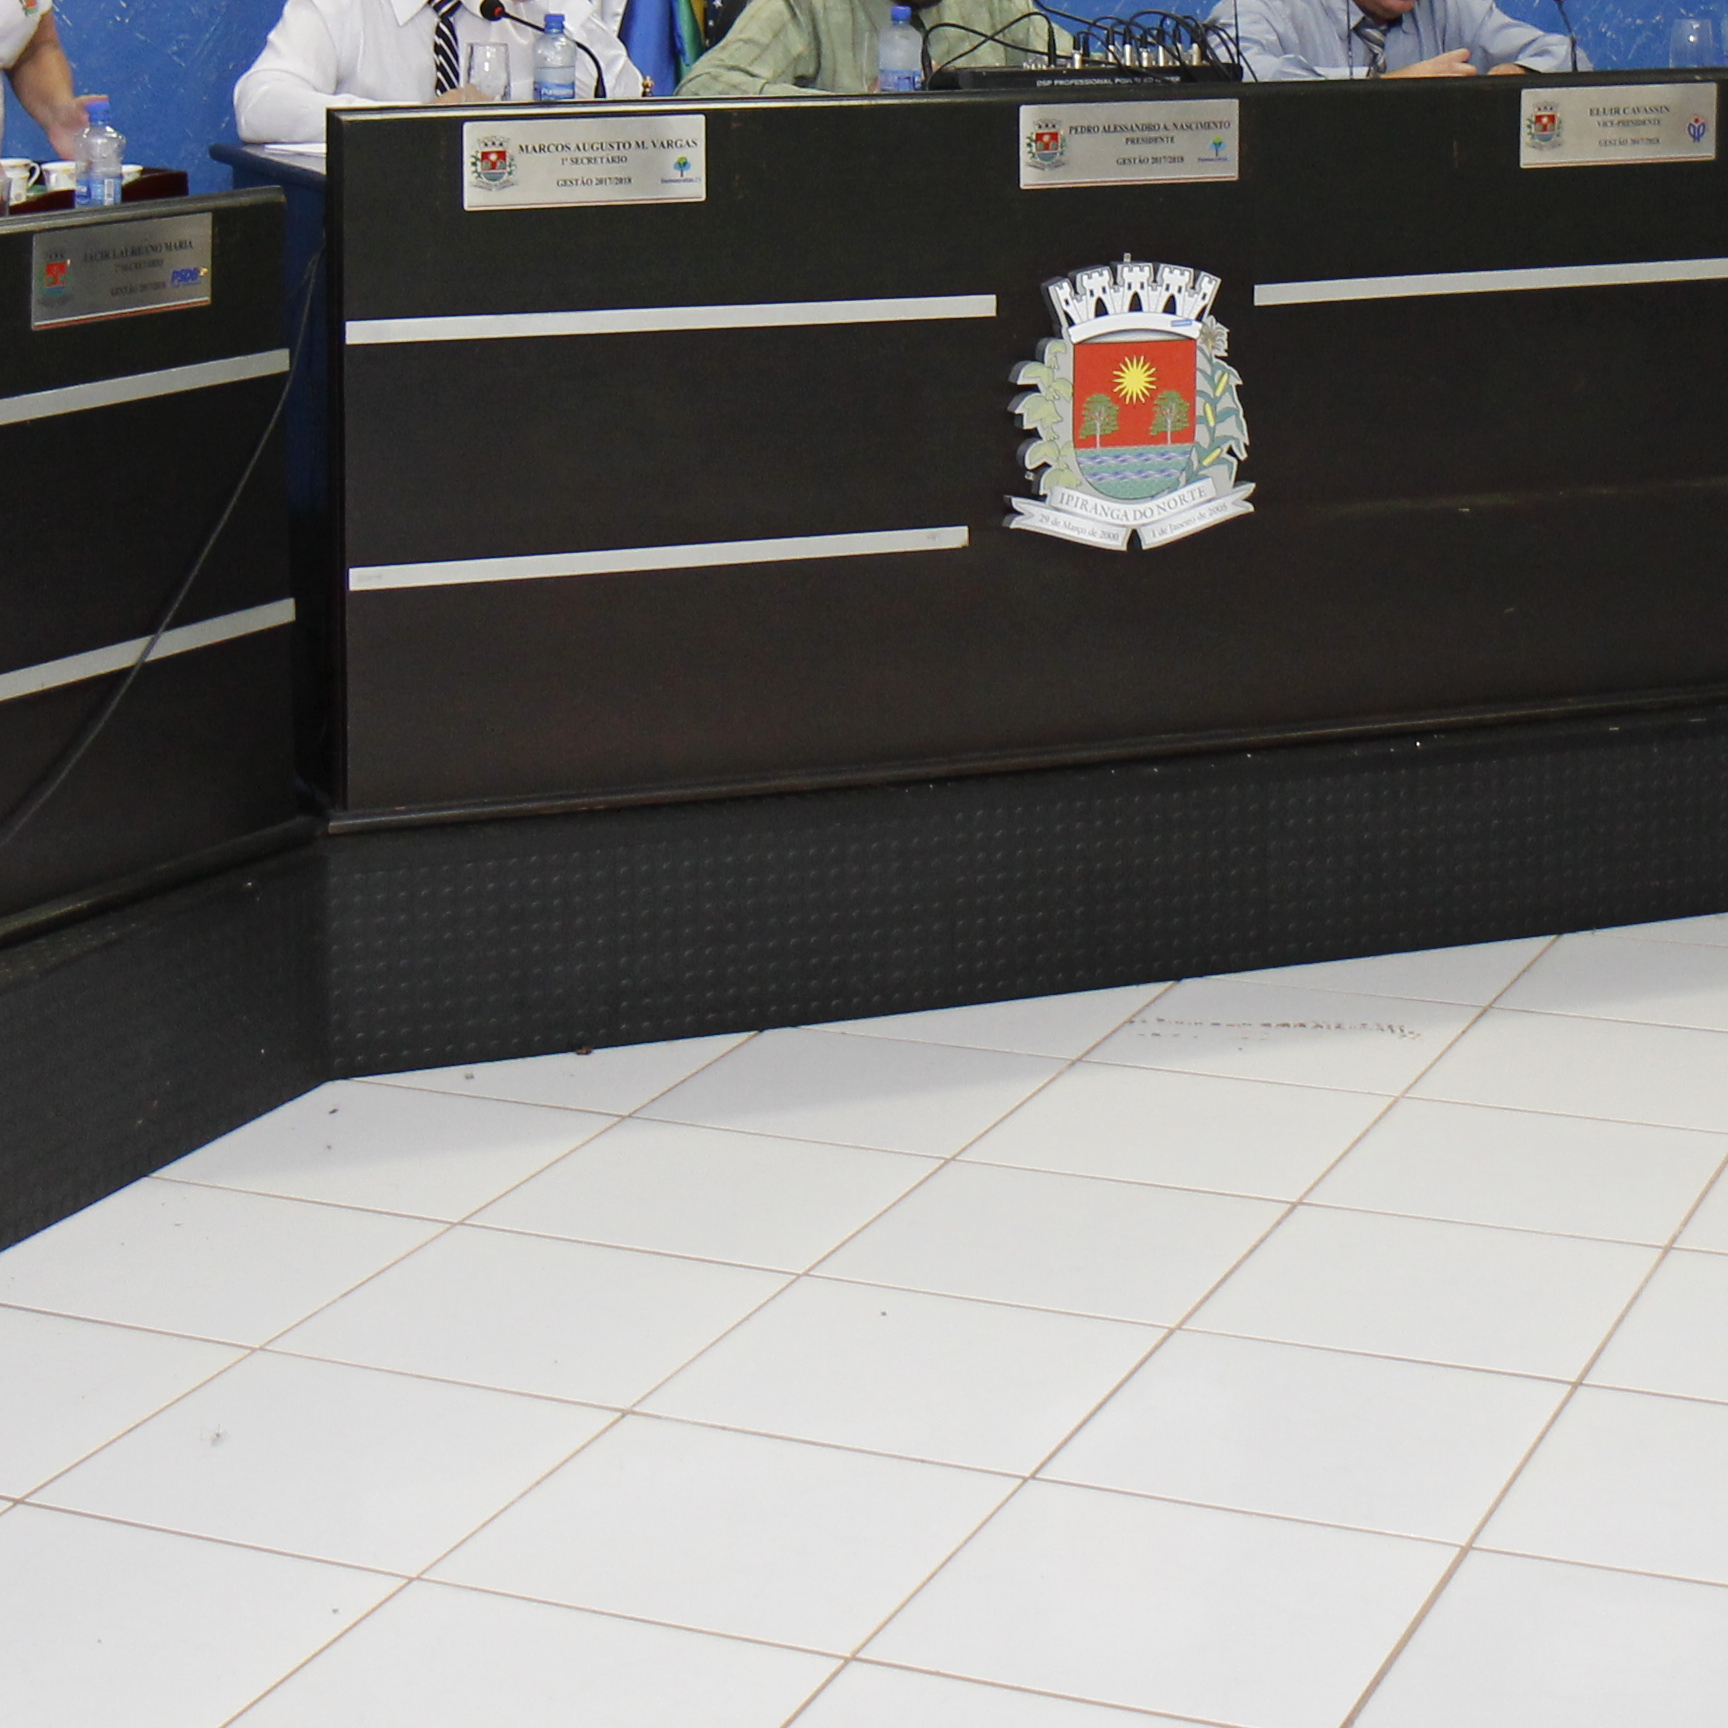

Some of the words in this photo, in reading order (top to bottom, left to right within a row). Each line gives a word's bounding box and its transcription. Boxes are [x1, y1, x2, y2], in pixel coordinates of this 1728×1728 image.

[1588, 107, 1621, 117] ELUIR
[1068, 124, 1100, 135] PEDRO
[1101, 122, 1161, 134] ALESSANDRO
[1172, 120, 1232, 131] NASCIMENTO
[518, 142, 572, 155] MARCOS
[573, 140, 632, 153] AUGUSTO
[650, 138, 699, 150] VARGAS
[1125, 136, 1176, 145] PRESIDENTE
[1116, 155, 1150, 166] GESTÃO
[556, 175, 594, 188] GESTÃO
[594, 176, 633, 187] 2017/2018
[1058, 492, 1131, 522] IPIRANGA
[1132, 508, 1153, 522] DO
[1153, 486, 1208, 513] NORTE
[1038, 513, 1050, 523] 29
[1051, 517, 1061, 526] de
[1088, 528, 1098, 537] de
[1099, 529, 1120, 541] 2000
[1158, 526, 1169, 536] de
[1197, 512, 1208, 521] de
